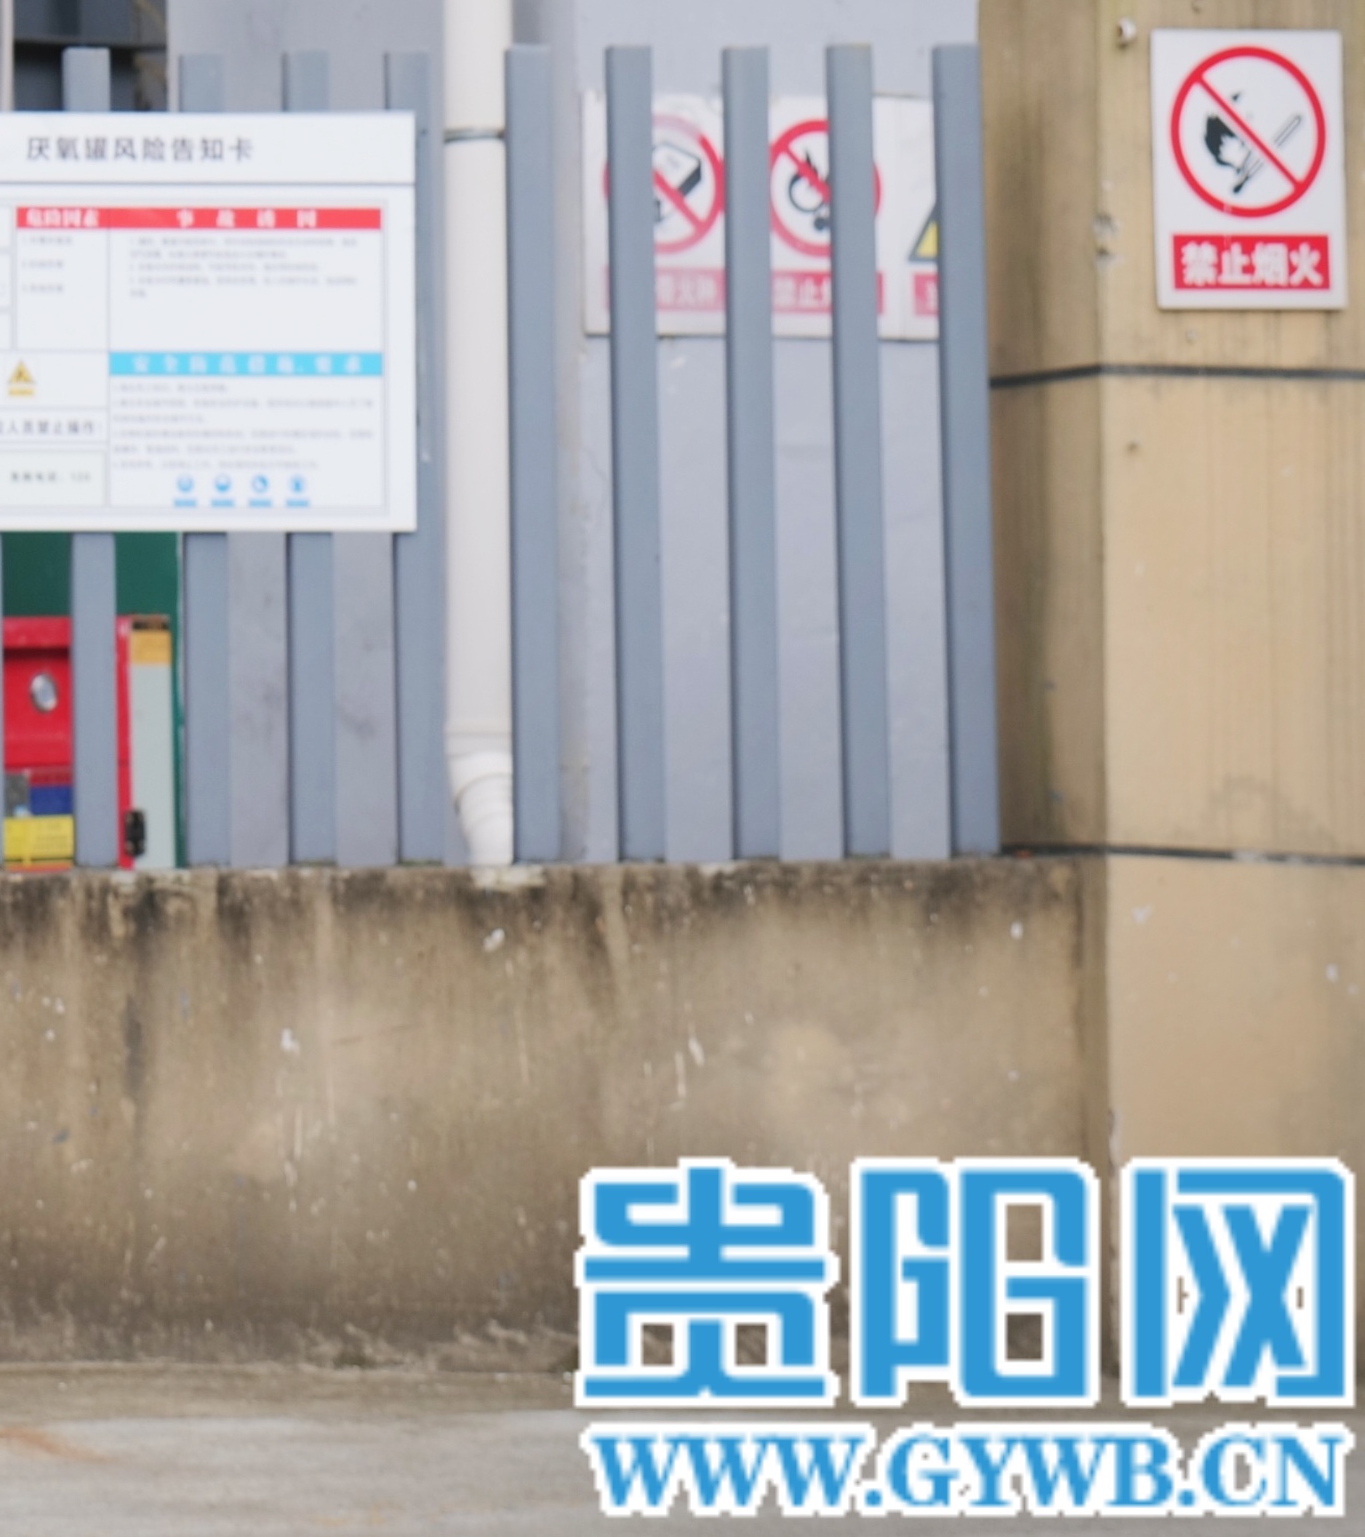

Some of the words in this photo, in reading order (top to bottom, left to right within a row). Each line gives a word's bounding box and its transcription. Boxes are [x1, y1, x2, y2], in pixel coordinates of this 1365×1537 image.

[26, 135, 253, 162] 厌氧罐风险告知卡
[1180, 240, 1324, 288] 禁止烟火
